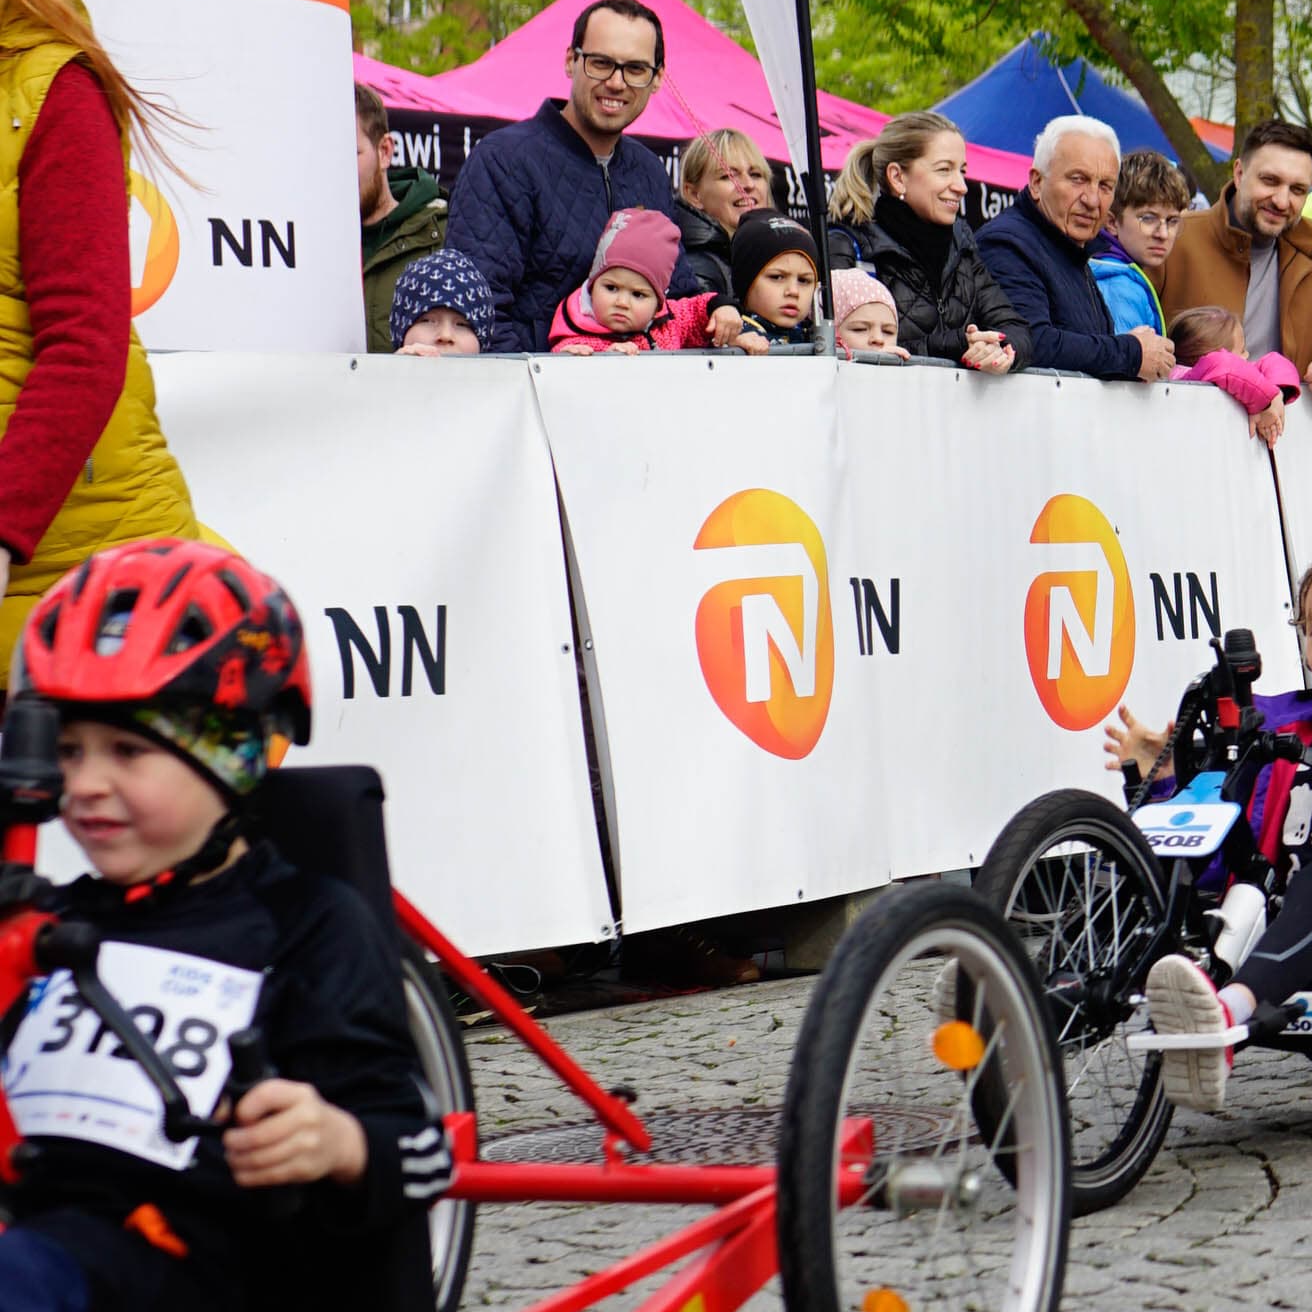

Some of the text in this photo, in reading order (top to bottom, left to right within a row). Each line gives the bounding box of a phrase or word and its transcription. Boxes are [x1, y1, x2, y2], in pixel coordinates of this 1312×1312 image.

[390, 123, 440, 170] awi
[207, 217, 296, 269] NN
[1149, 571, 1222, 640] NN
[324, 604, 447, 700] NN
[1148, 834, 1206, 848] SOB
